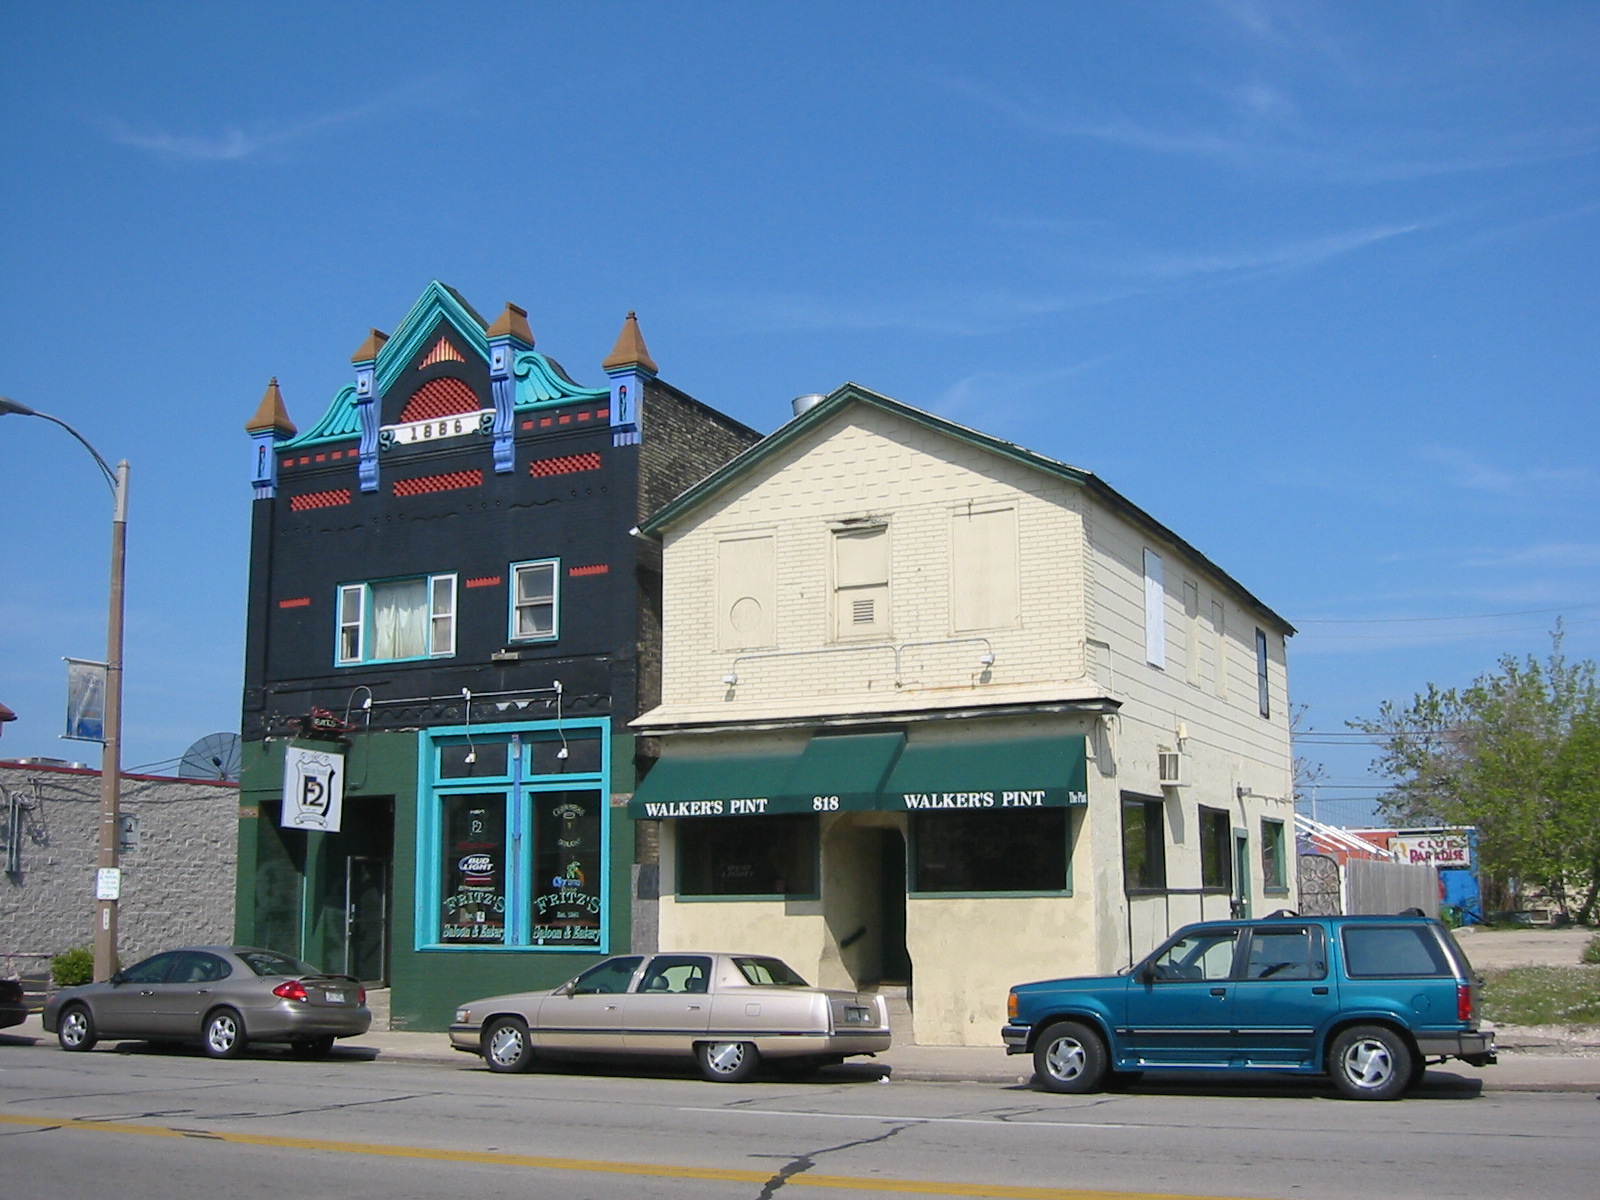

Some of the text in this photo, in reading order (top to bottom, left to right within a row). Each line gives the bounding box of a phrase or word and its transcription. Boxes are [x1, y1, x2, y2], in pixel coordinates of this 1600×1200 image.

[410, 419, 462, 441] 1886
[645, 798, 769, 818] WALKER'S PINT
[812, 795, 840, 811] 818
[903, 791, 1046, 810] WALKER'S PINT
[1409, 849, 1464, 863] PARADISE
[463, 863, 494, 871] LIGHT
[443, 892, 505, 915] FRITZ'S
[534, 892, 601, 915] FRITZ'S
